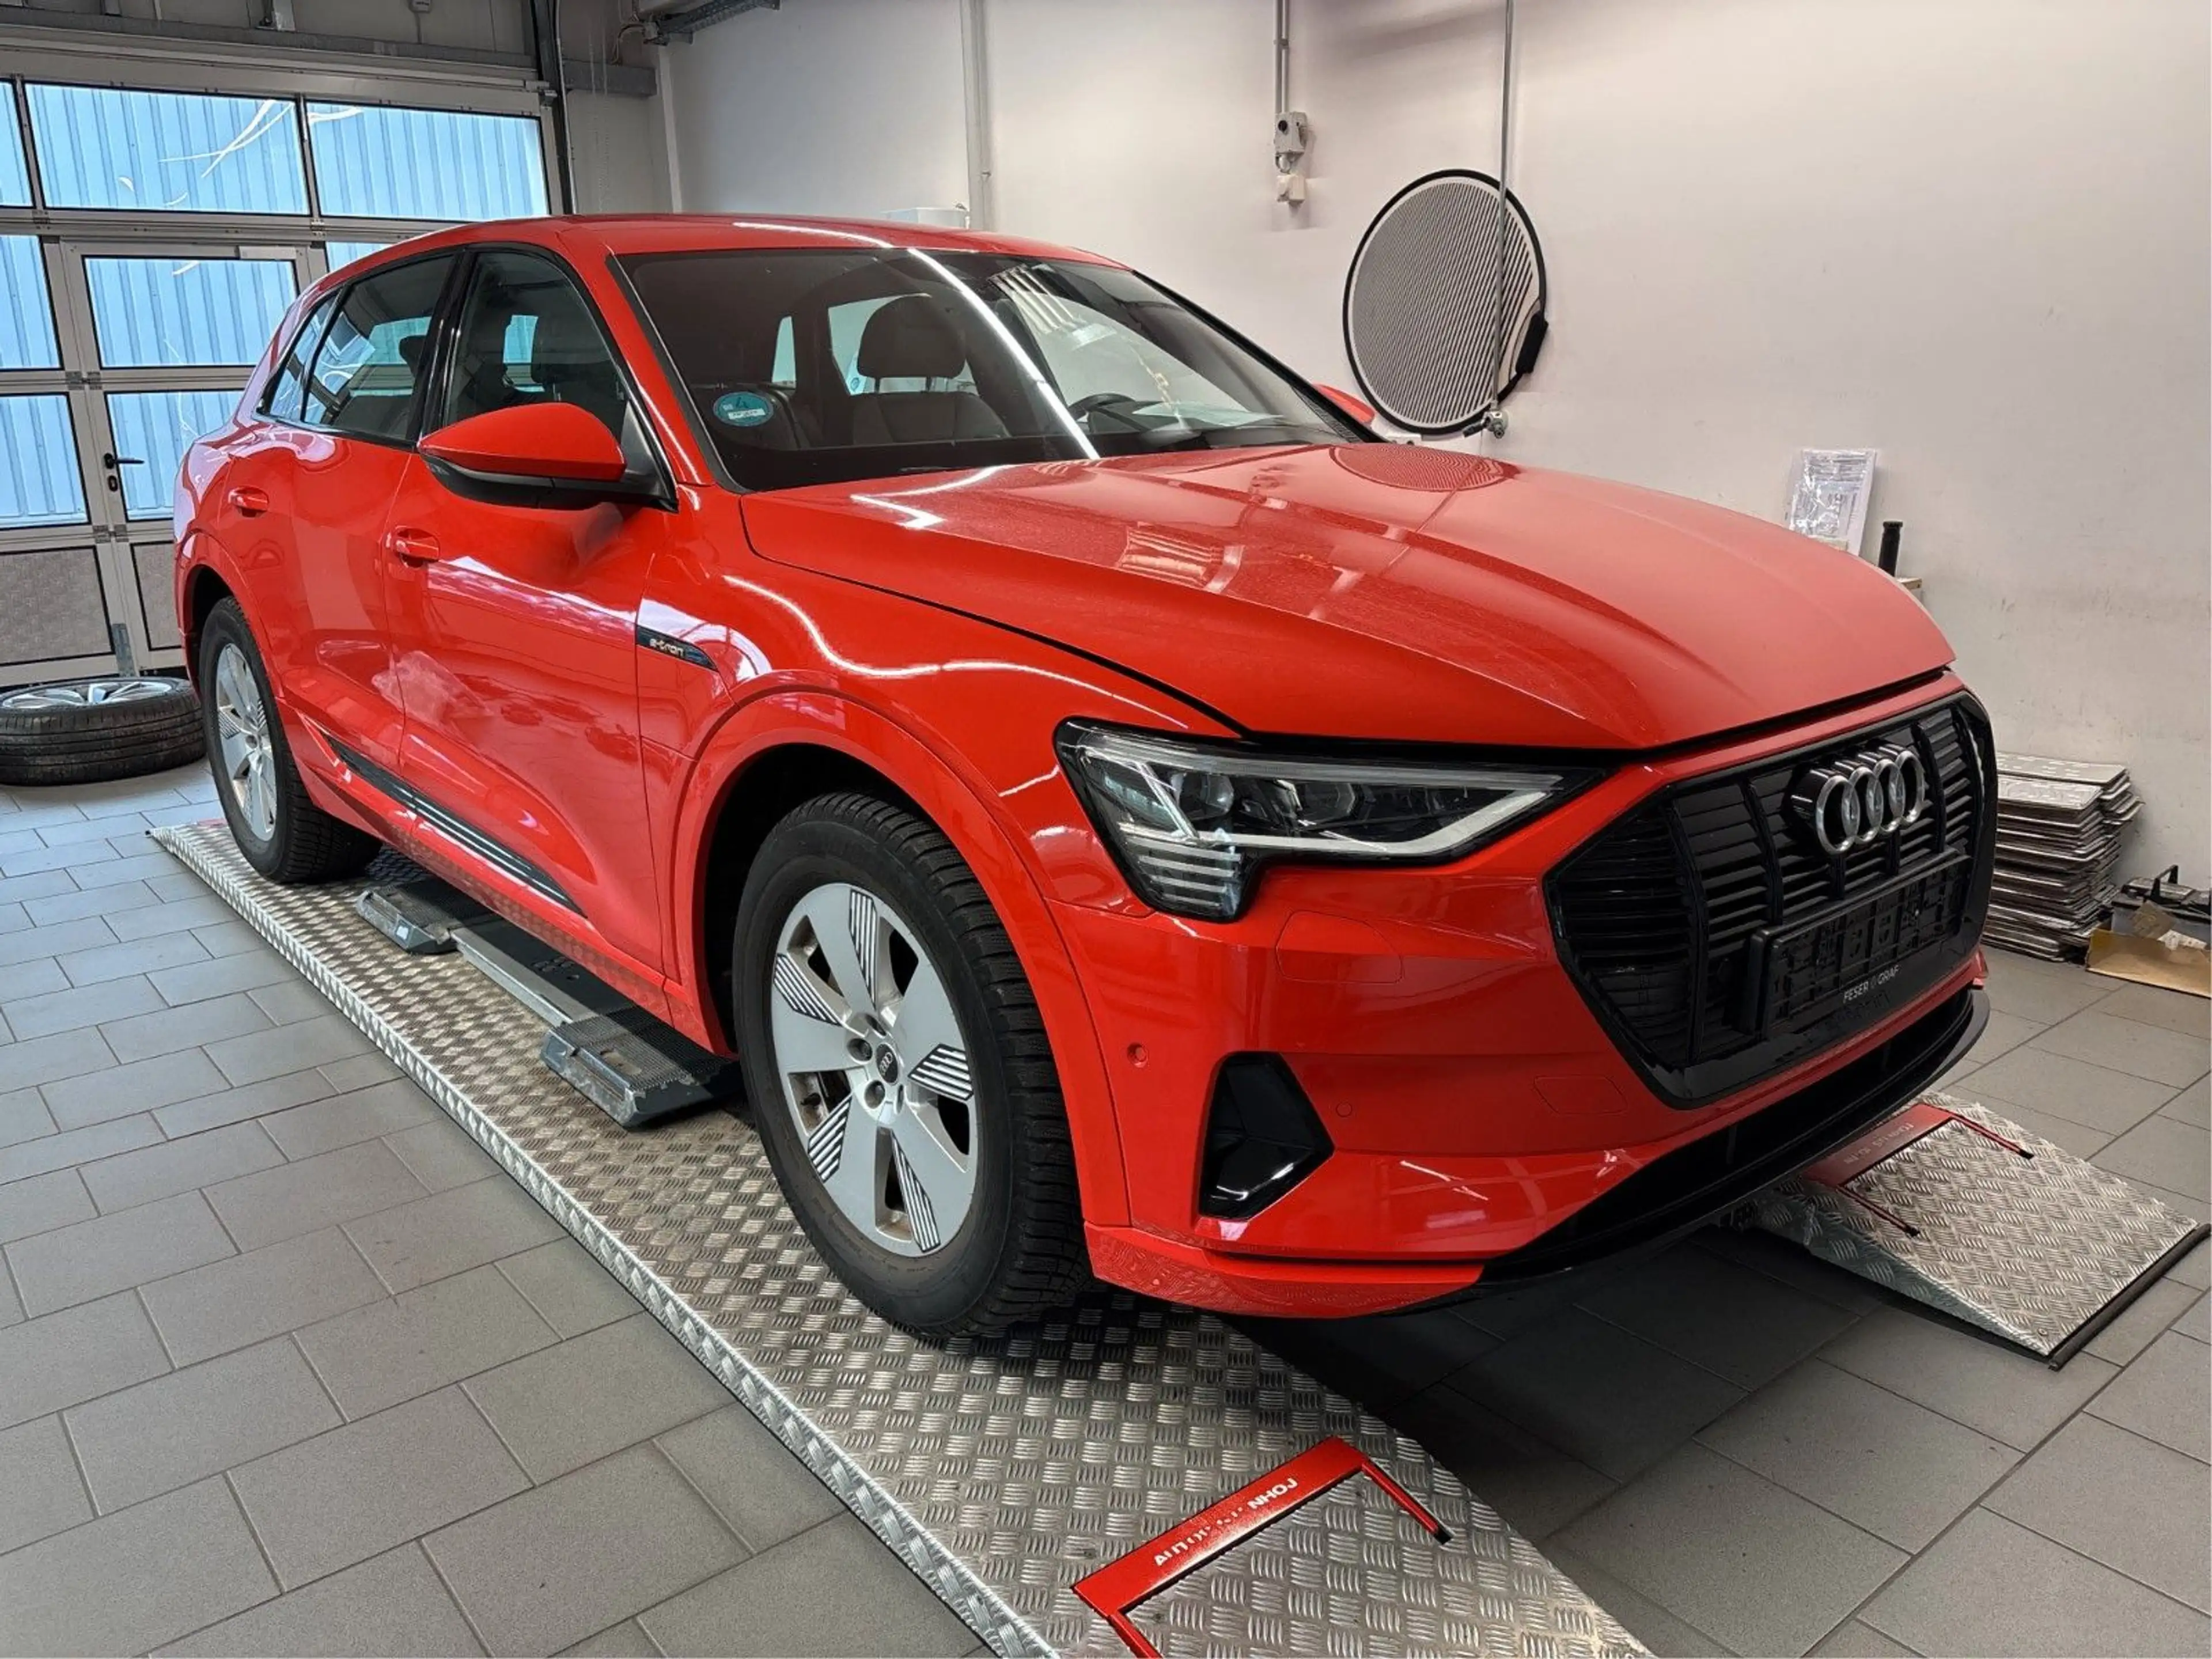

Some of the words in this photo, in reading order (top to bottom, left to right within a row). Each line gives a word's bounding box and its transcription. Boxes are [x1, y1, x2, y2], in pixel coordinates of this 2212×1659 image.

[649, 638, 684, 657] e-tron
[1843, 980, 1869, 1003] FESER
[1878, 964, 1900, 984] GRAF
